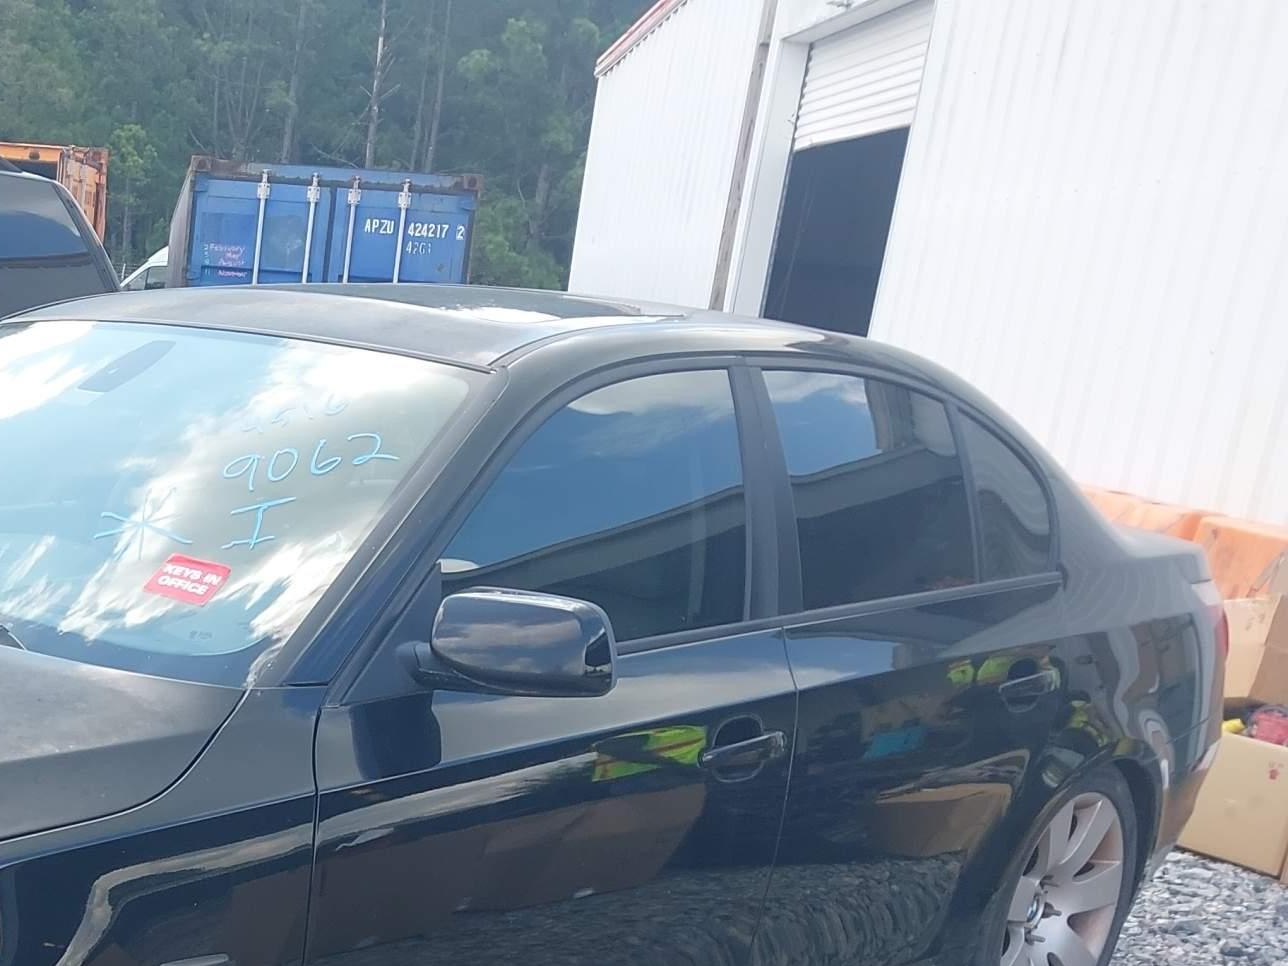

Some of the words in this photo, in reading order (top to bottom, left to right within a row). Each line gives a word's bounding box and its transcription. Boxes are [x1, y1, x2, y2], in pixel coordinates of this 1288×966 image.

[364, 218, 394, 234] APZU
[408, 222, 449, 238] 424217
[456, 225, 465, 240] 2
[223, 432, 400, 492] 9062
[157, 575, 208, 595] OFFICE
[163, 564, 203, 580] KEYS
[203, 573, 222, 585] IN
